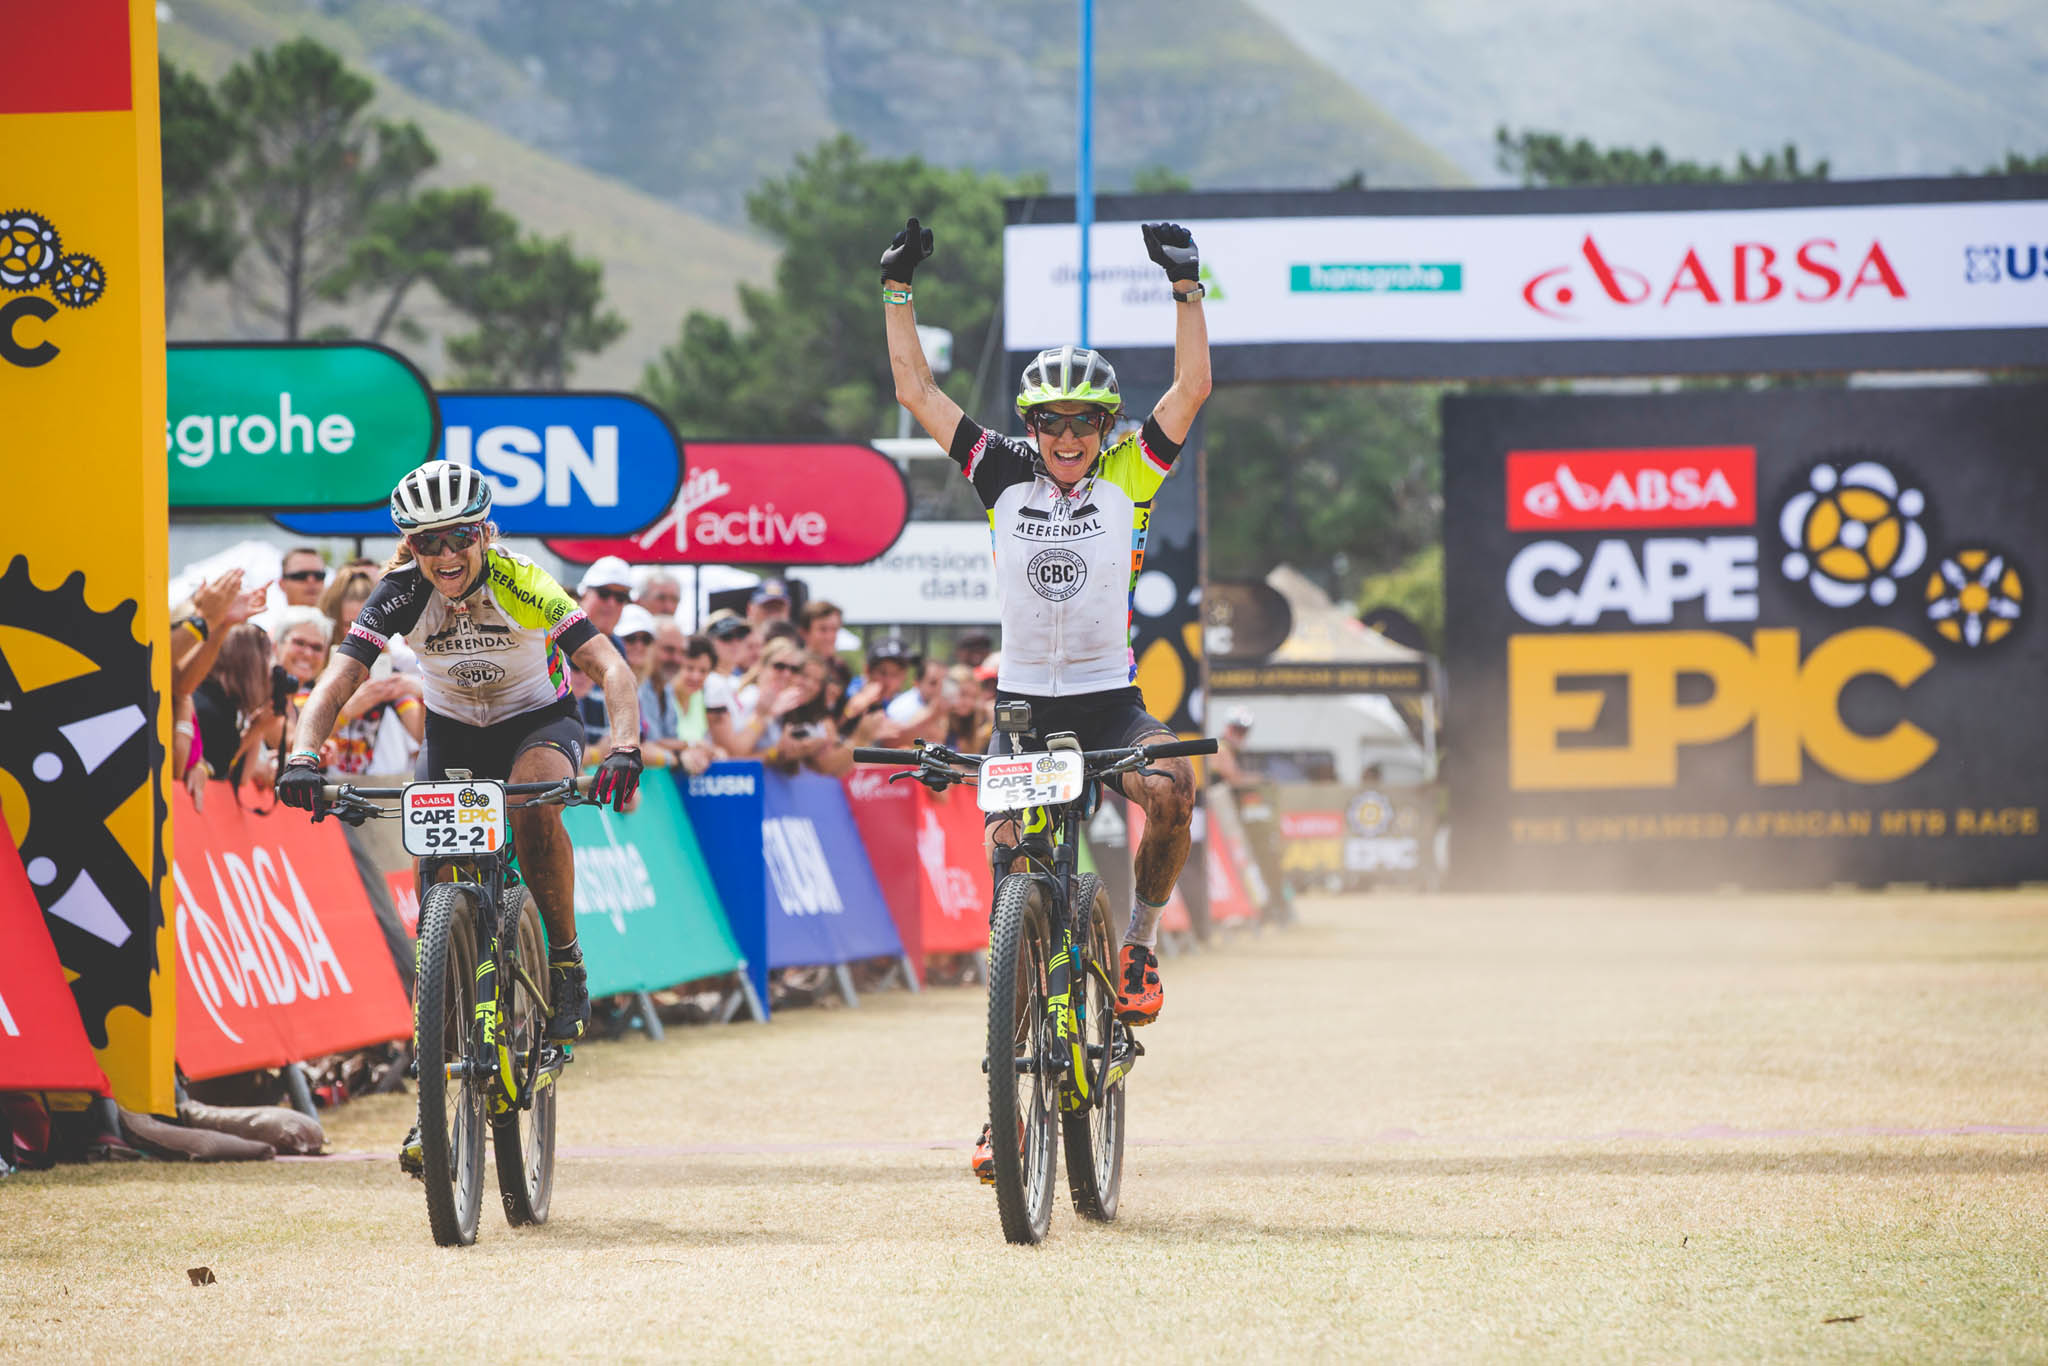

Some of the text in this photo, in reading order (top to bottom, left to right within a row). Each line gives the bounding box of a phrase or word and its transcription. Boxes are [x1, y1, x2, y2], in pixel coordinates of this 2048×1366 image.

[1662, 239, 1909, 306] ABSA
[2007, 246, 2048, 282] U
[1602, 468, 1737, 511] ABSA
[694, 503, 827, 545] active
[1016, 519, 1102, 537] MEERENDAL
[1030, 555, 1044, 570] CAPE
[1040, 564, 1074, 584] CBC
[1506, 536, 1760, 626] CAPE
[1508, 627, 1939, 790] EPIC
[986, 774, 1032, 789] CAPE
[1005, 785, 1057, 803] 52-1
[428, 797, 452, 805] ABSA
[410, 808, 497, 825] CAPE EPIC
[1511, 817, 1568, 843] THE
[1733, 811, 1871, 838] AFRICAN
[1880, 809, 1946, 836] MTB
[1956, 808, 2038, 835] RACE
[425, 826, 485, 848] 52-2
[204, 845, 353, 1008] ABSA
